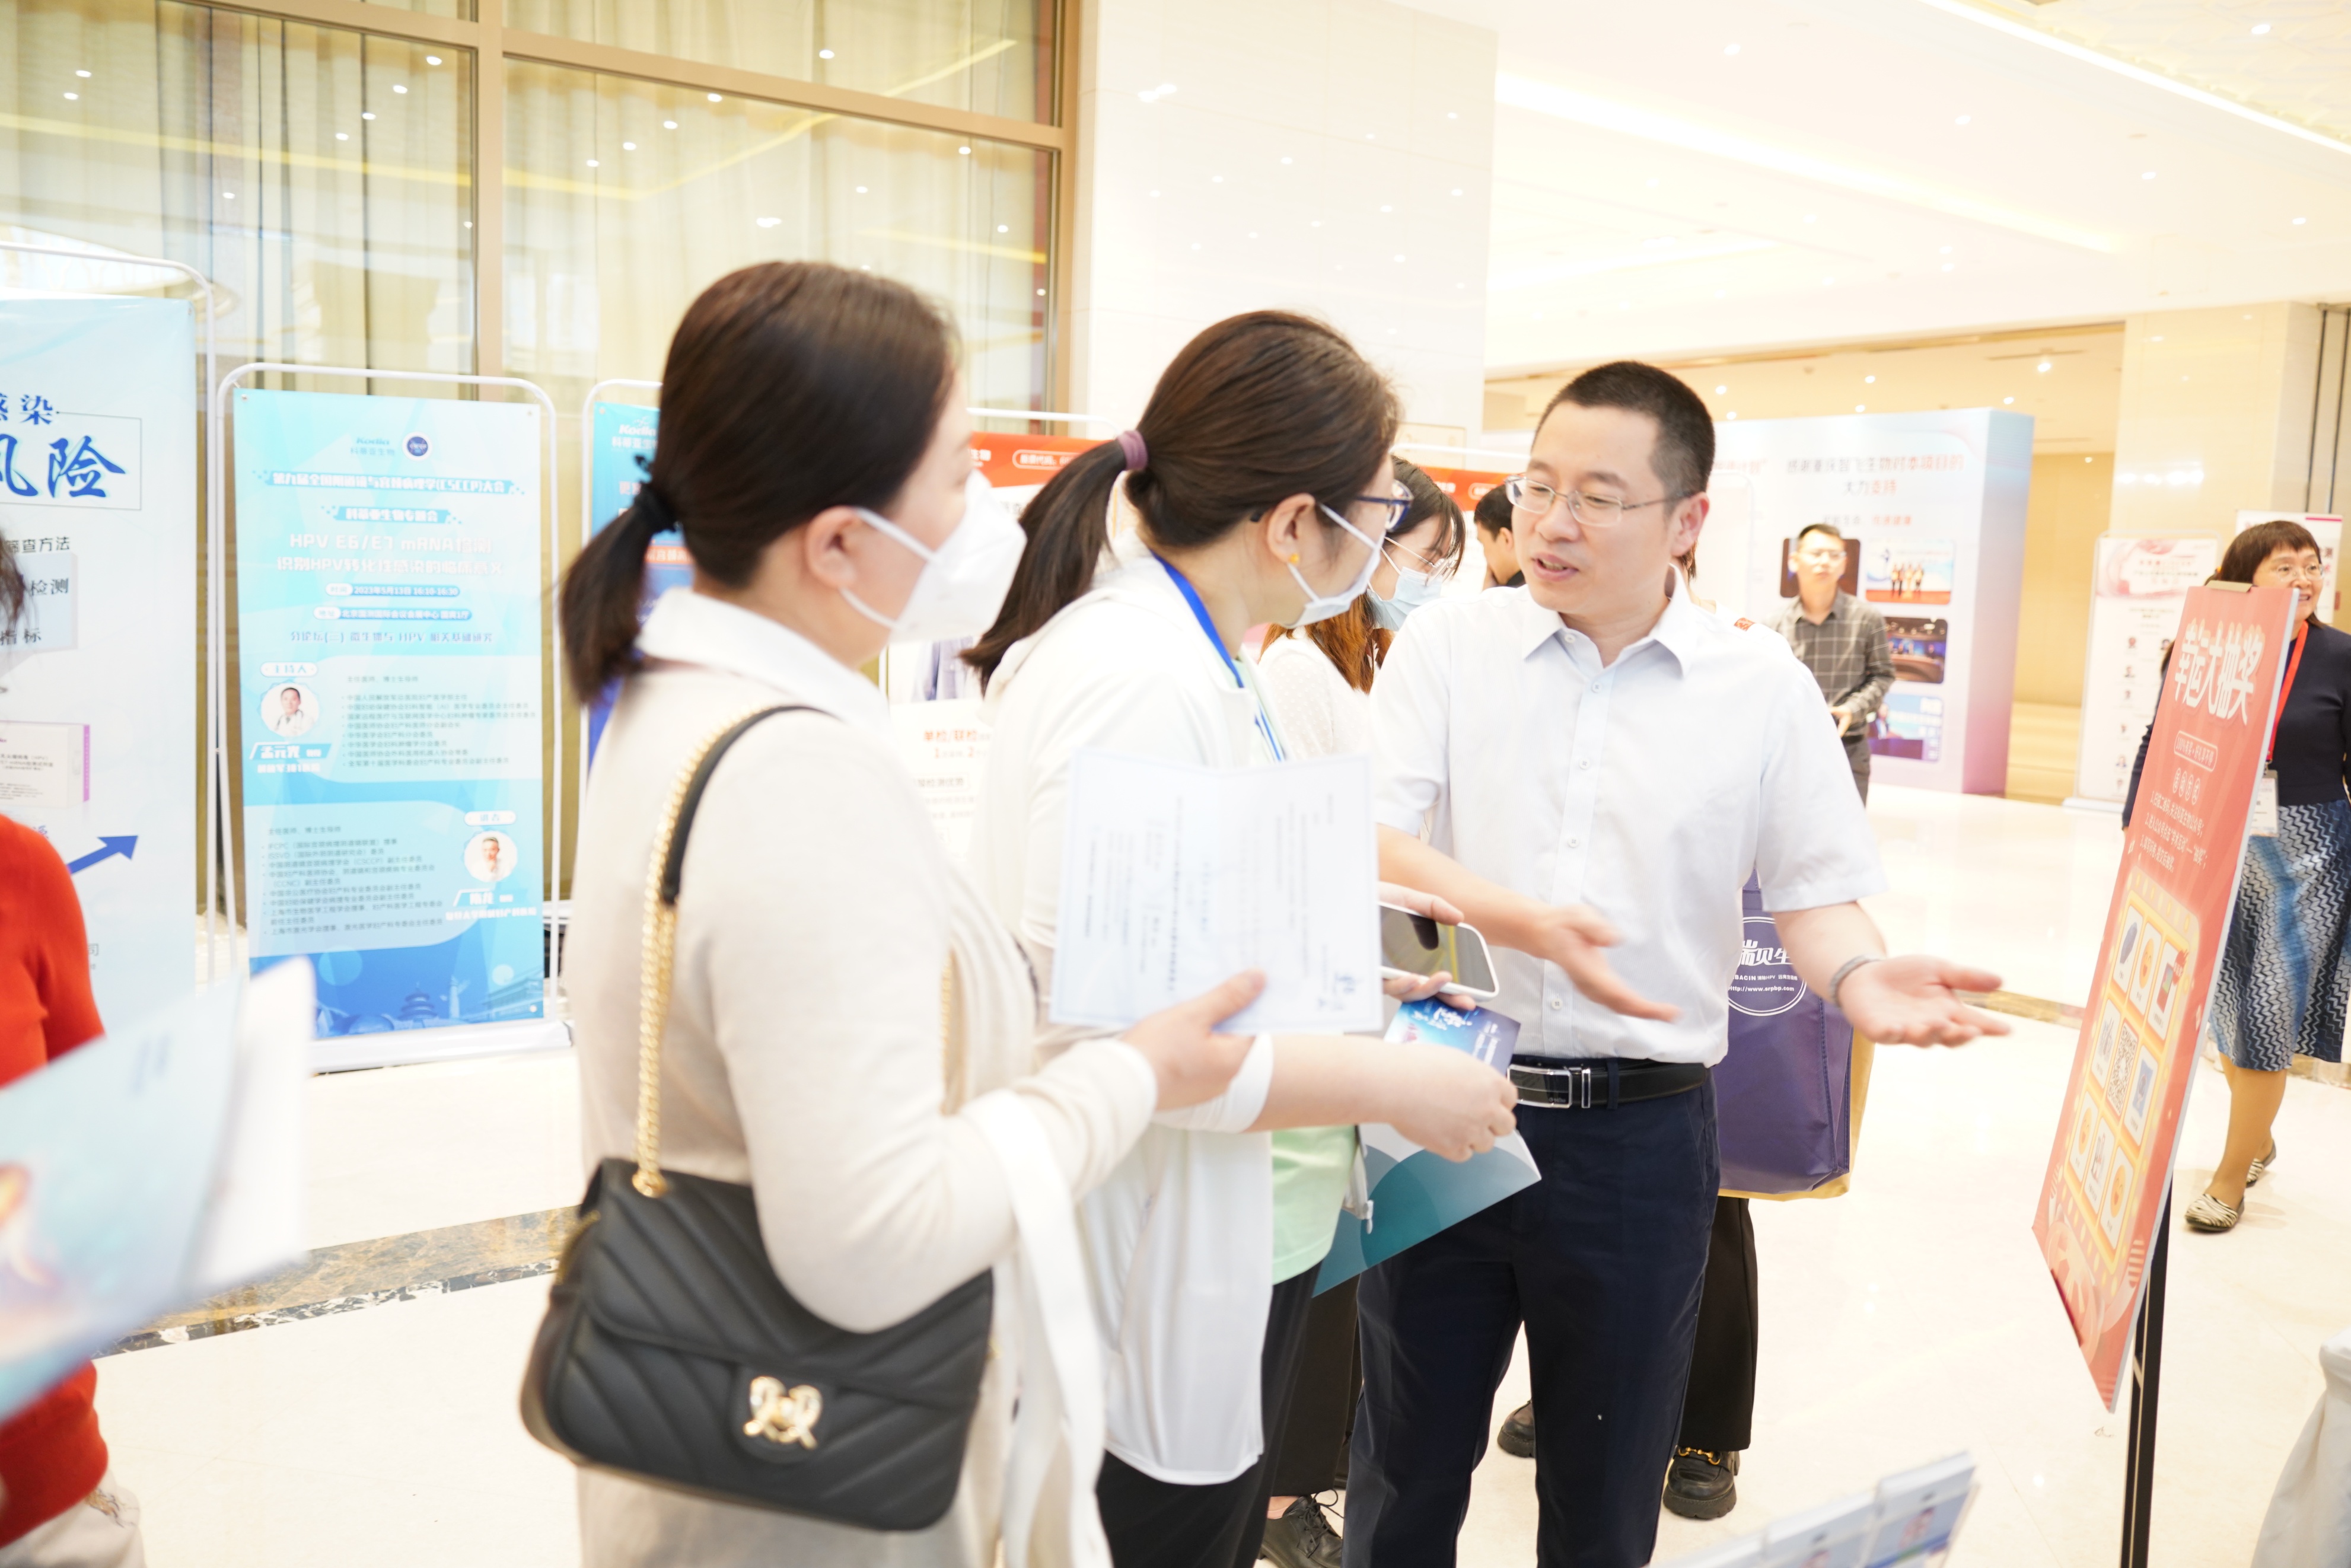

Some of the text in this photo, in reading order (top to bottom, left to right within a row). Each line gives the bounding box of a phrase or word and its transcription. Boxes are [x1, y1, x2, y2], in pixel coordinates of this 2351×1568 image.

[0, 393, 53, 425] 染
[290, 533, 329, 549] HPV
[336, 534, 394, 550] E6/E7
[399, 632, 425, 642] HPV
[2174, 619, 2264, 727] 幸运大抽奖
